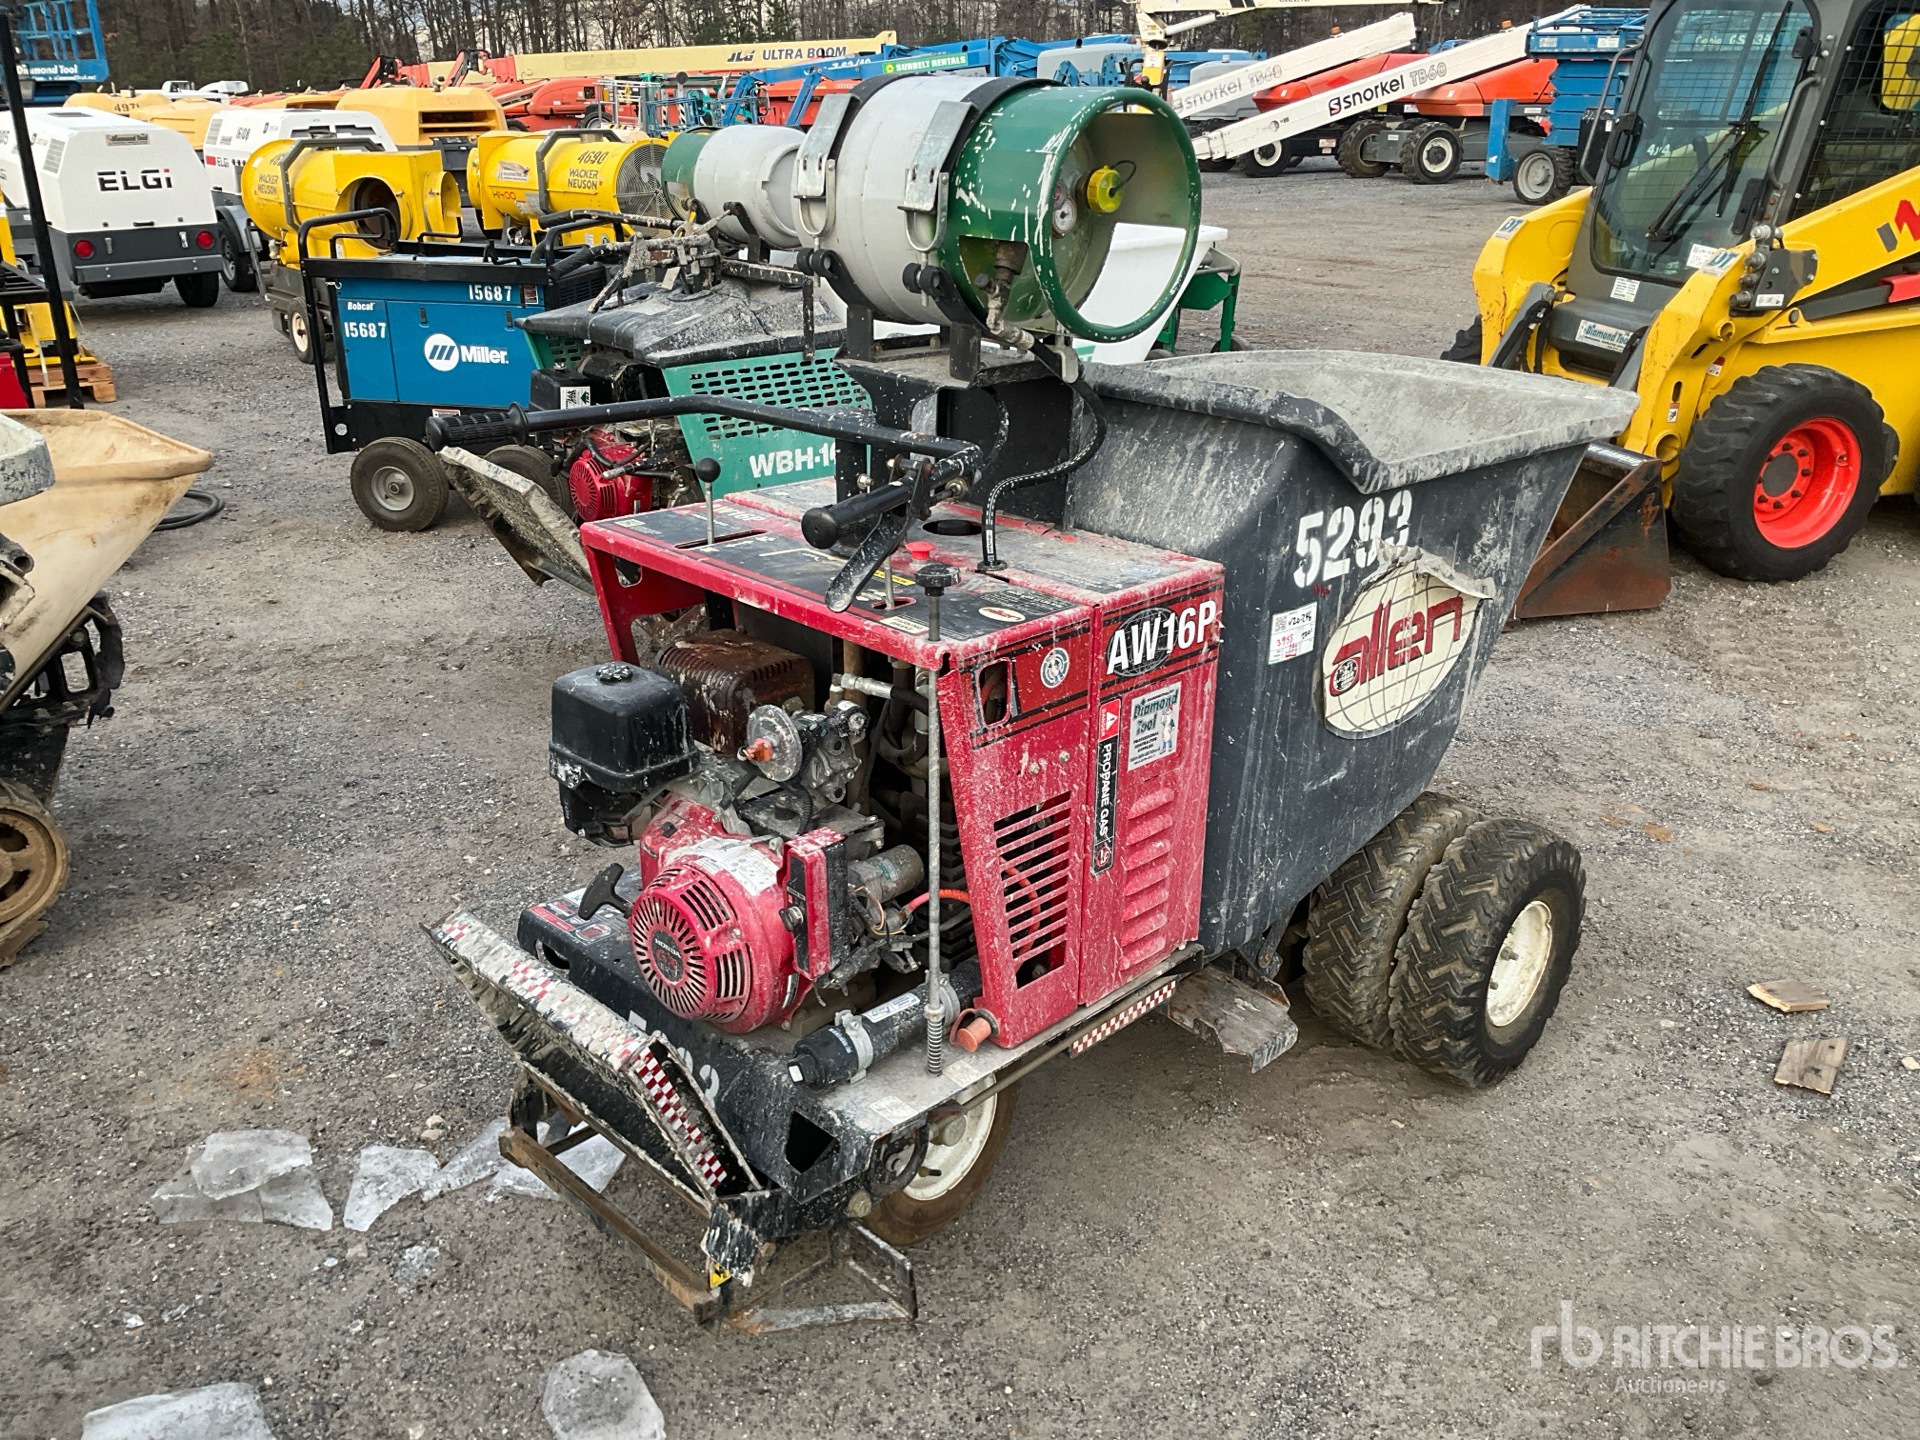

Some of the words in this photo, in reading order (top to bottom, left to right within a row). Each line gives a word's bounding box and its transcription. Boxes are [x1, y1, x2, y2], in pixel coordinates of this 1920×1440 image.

[726, 50, 756, 62] JLG
[762, 48, 803, 60] ULTRA
[807, 46, 846, 58] BOOM
[59, 64, 79, 75] Tool
[895, 61, 930, 72] SUNBELT
[932, 55, 967, 67] RENTALS
[1185, 78, 1242, 110] snorkel
[1343, 75, 1405, 109] snorkel
[1409, 62, 1448, 87] TB60
[578, 150, 609, 165] 4690
[258, 174, 279, 185] WACKER
[569, 168, 599, 180] WACKER
[567, 178, 598, 190] NEUSON
[1707, 251, 1740, 269] DT
[468, 284, 512, 302] 15687
[347, 301, 373, 311] Bobcat
[344, 322, 387, 339] 15687
[1585, 324, 1618, 341] Diamond
[1293, 490, 1413, 588] 5293
[1106, 601, 1217, 675] AW16P
[1329, 595, 1463, 697] allen
[1133, 690, 1180, 720] Diamond
[1136, 713, 1158, 736] Tool
[1100, 743, 1112, 808] PROPANE
[1099, 809, 1110, 837] GAS
[654, 937, 682, 959] HONDA
